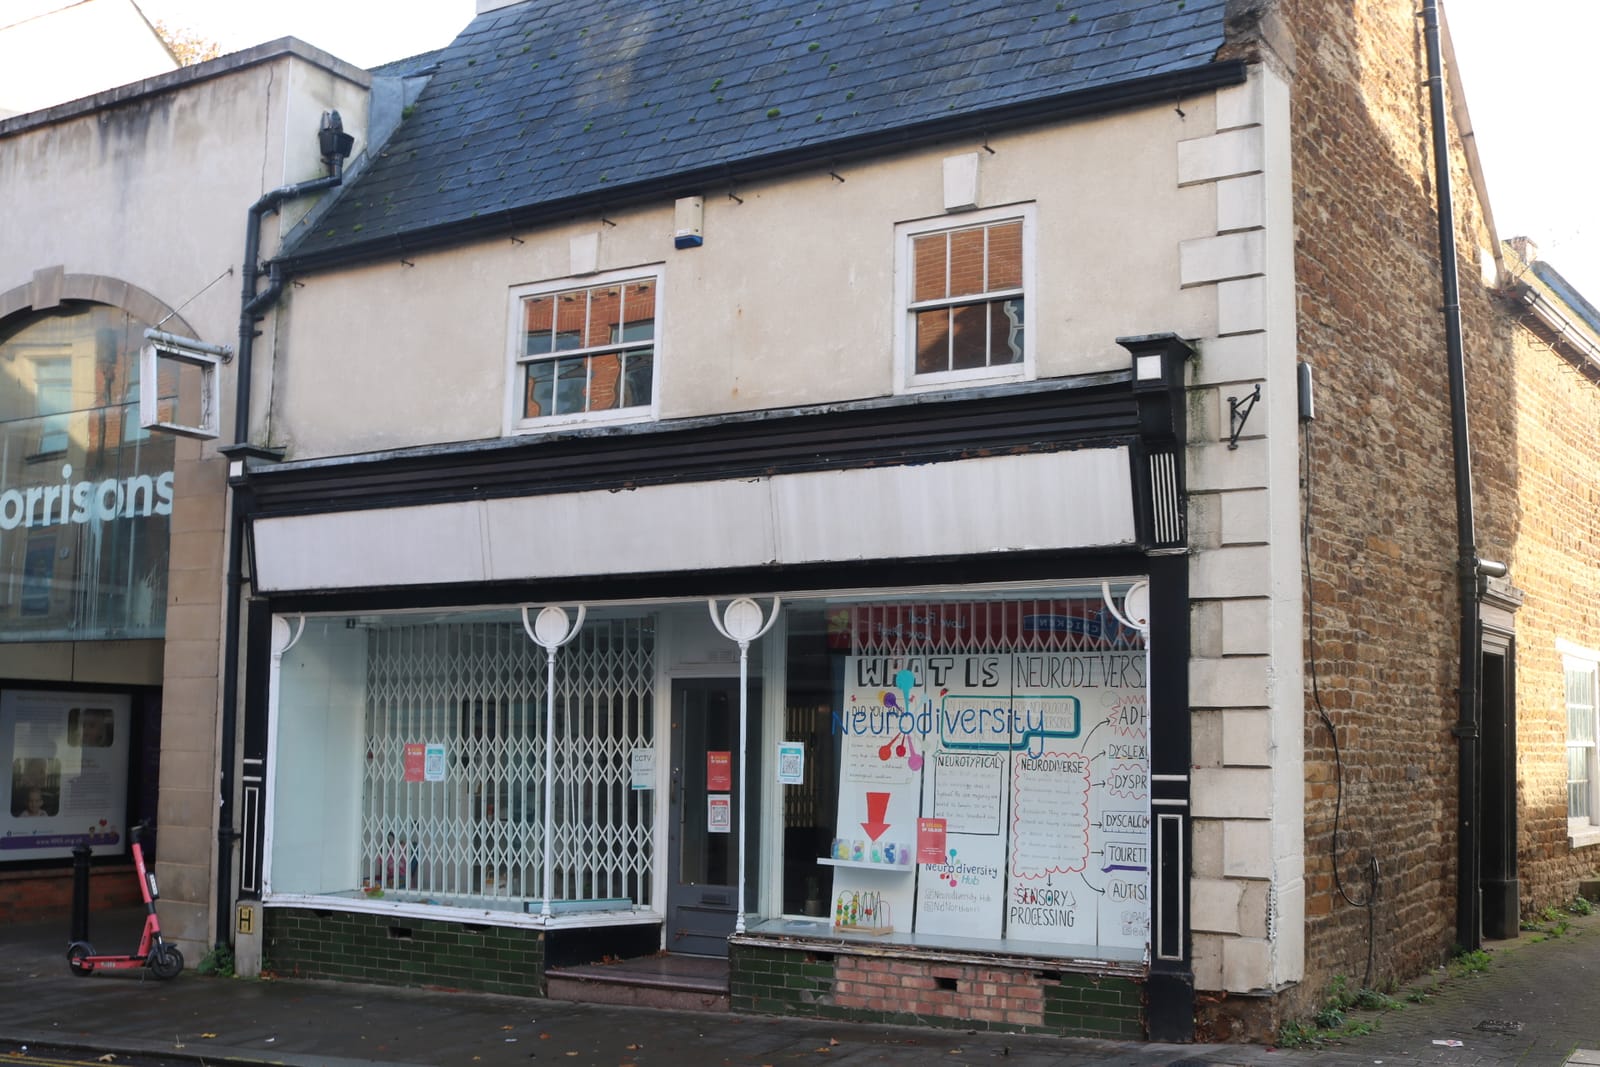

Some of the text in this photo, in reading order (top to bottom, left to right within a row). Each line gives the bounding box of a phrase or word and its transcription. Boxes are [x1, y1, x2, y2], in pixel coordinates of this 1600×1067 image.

[858, 657, 954, 687] WHAT
[965, 657, 999, 688] IS
[831, 699, 1045, 760] Neurodiversity
[937, 756, 1000, 769] NEUROTYPICAL
[1021, 758, 1084, 773] NEURODIVERSE
[925, 862, 998, 879] Neurodiversity
[961, 874, 980, 886] Hub
[1016, 887, 1068, 907] SENSORY
[239, 908, 252, 931] H
[1010, 907, 1075, 928] PROCESSING
